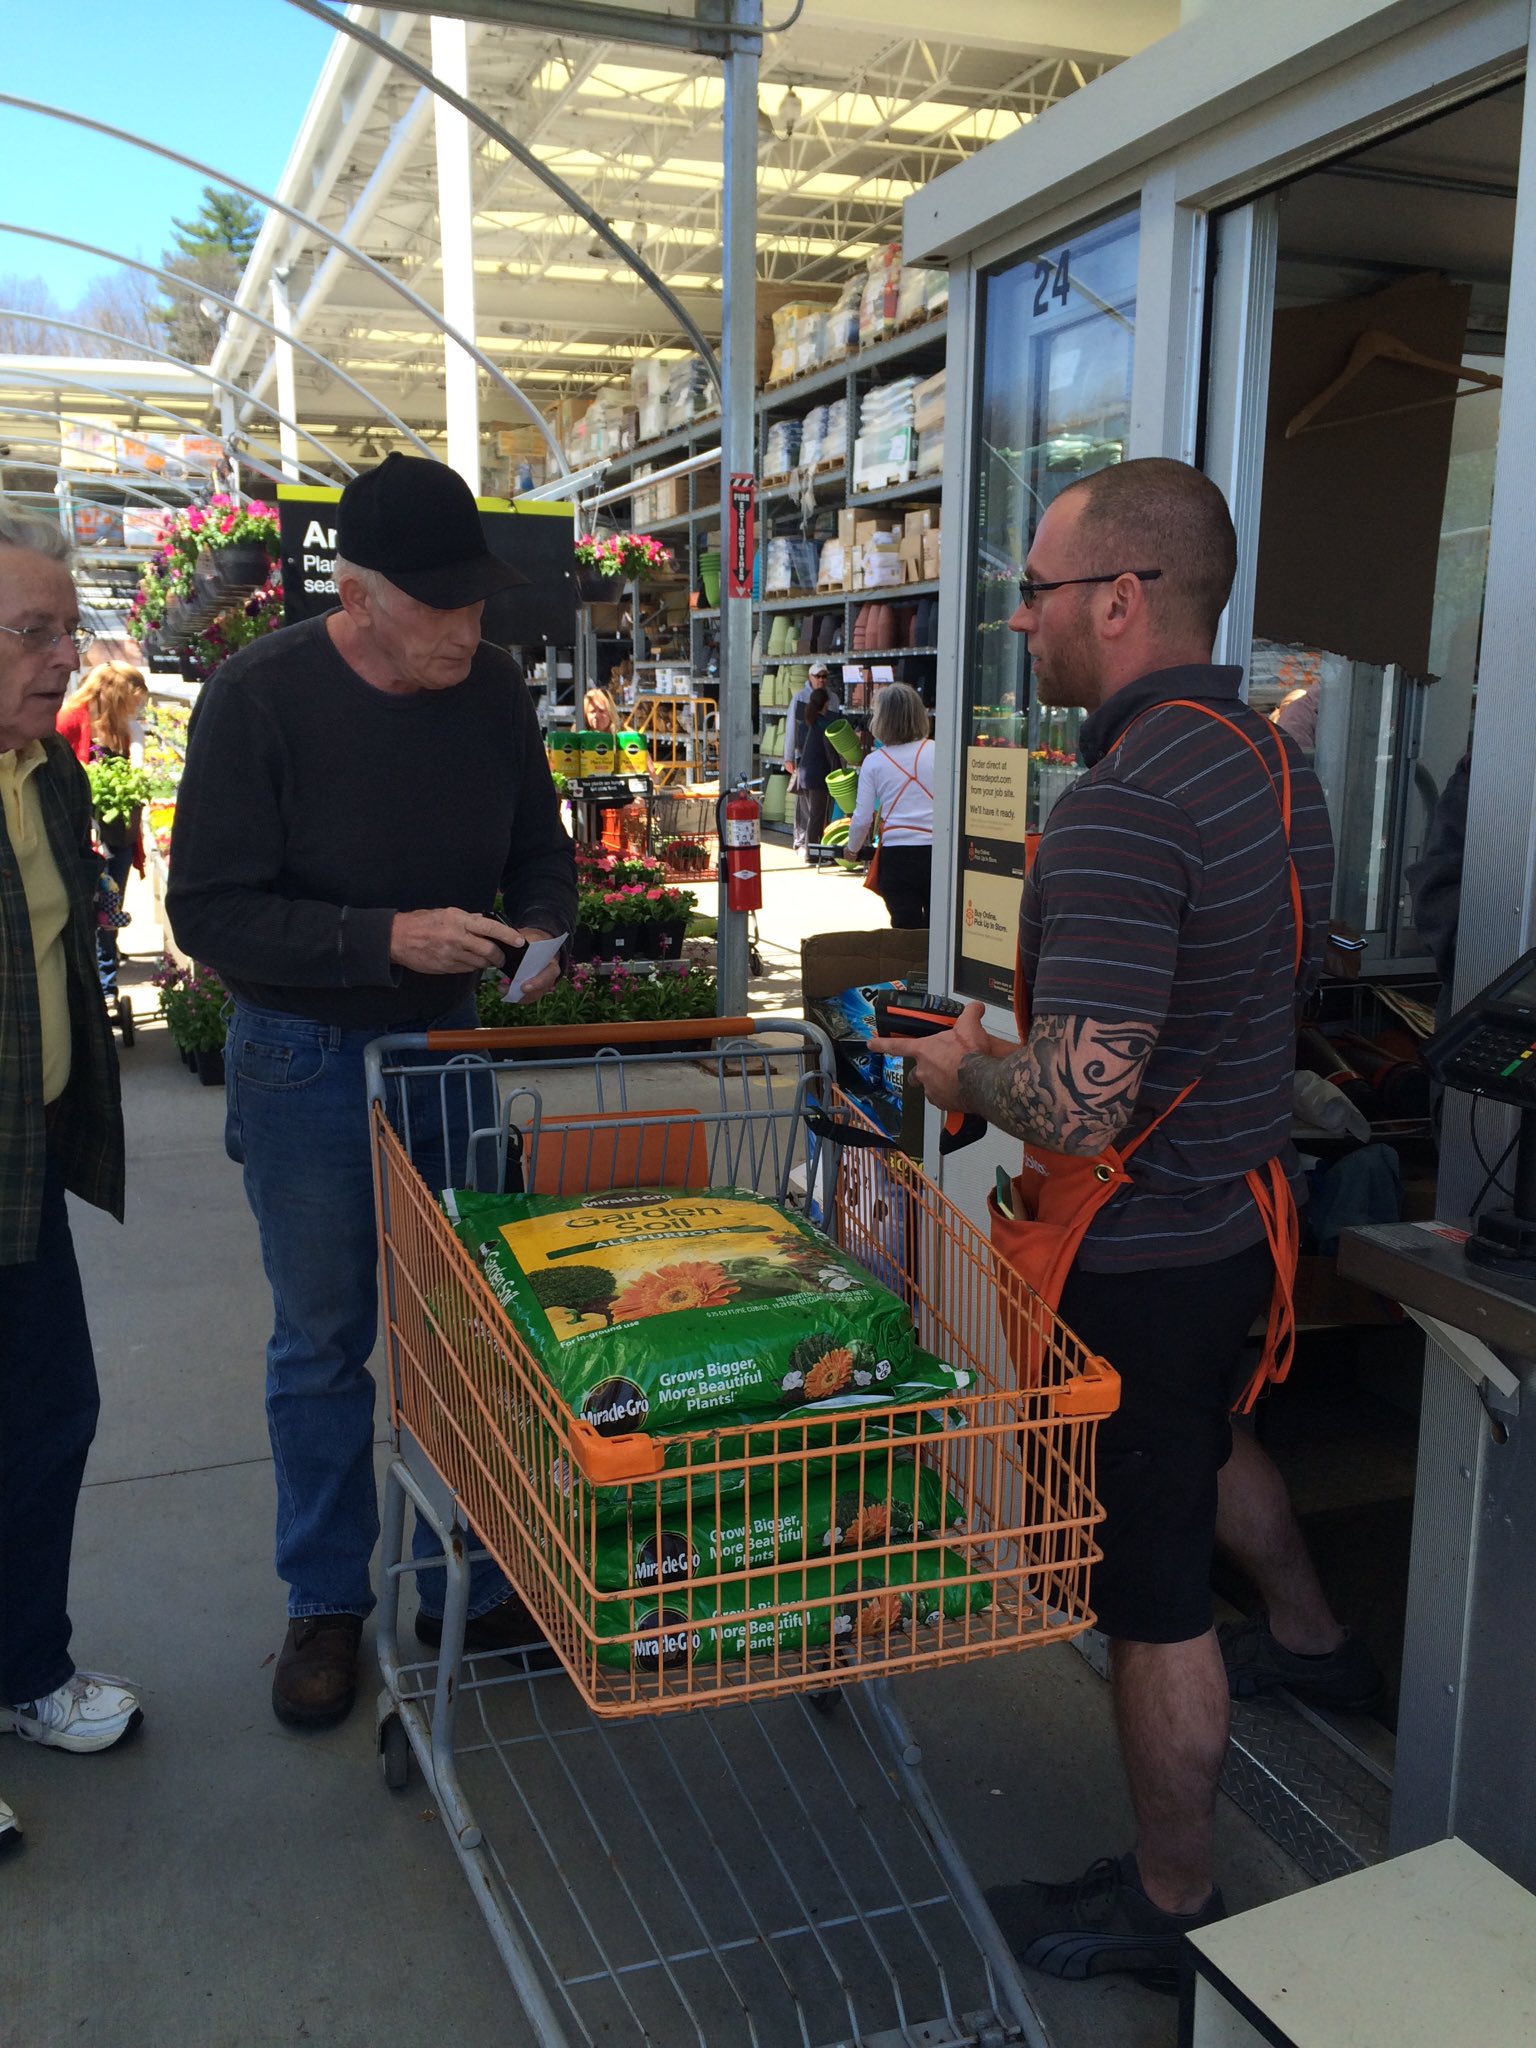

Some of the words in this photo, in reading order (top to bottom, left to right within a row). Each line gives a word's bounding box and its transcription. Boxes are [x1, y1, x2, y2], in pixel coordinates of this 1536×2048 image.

[1033, 248, 1070, 317] 24
[733, 493, 750, 501] FIRE
[303, 579, 338, 593] sea
[971, 759, 985, 770] Order
[986, 760, 1001, 770] direct
[1002, 762, 1007, 770] at
[971, 773, 1012, 785] homedepot.com
[970, 785, 982, 795] from
[982, 787, 994, 797] your
[994, 788, 1003, 798] job
[1004, 788, 1015, 798] site.
[969, 804, 982, 815] We'll
[982, 806, 994, 816] have
[995, 807, 1000, 816] it
[1000, 808, 1015, 820] ready.
[974, 908, 982, 919] Buy
[983, 911, 997, 921] Online.
[974, 918, 982, 926] Pick
[983, 920, 989, 929] Up
[995, 922, 1008, 932] Store.
[581, 1194, 672, 1209] Miracle-Gro
[565, 1205, 722, 1228] Garden
[615, 1217, 692, 1234] Soil
[594, 1236, 633, 1249] ALL
[636, 1226, 731, 1242] PURPOSE
[484, 1250, 508, 1292] Garden
[497, 1280, 520, 1308] Soil
[560, 1338, 576, 1350] For
[622, 1320, 640, 1330] use
[659, 1368, 705, 1387] Grows
[706, 1358, 758, 1379] Bigger,
[880, 1370, 888, 1378] CF
[658, 1383, 696, 1404] More
[697, 1369, 763, 1396] Beautiful
[579, 1397, 650, 1427] Miracle-Gro
[754, 1514, 801, 1534] Bigger,
[710, 1542, 744, 1560] More
[747, 1526, 806, 1550] Beautiful
[634, 1552, 701, 1580] Miracle-Go
[710, 1628, 746, 1641] More
[634, 1632, 701, 1658] Mirale-Go
